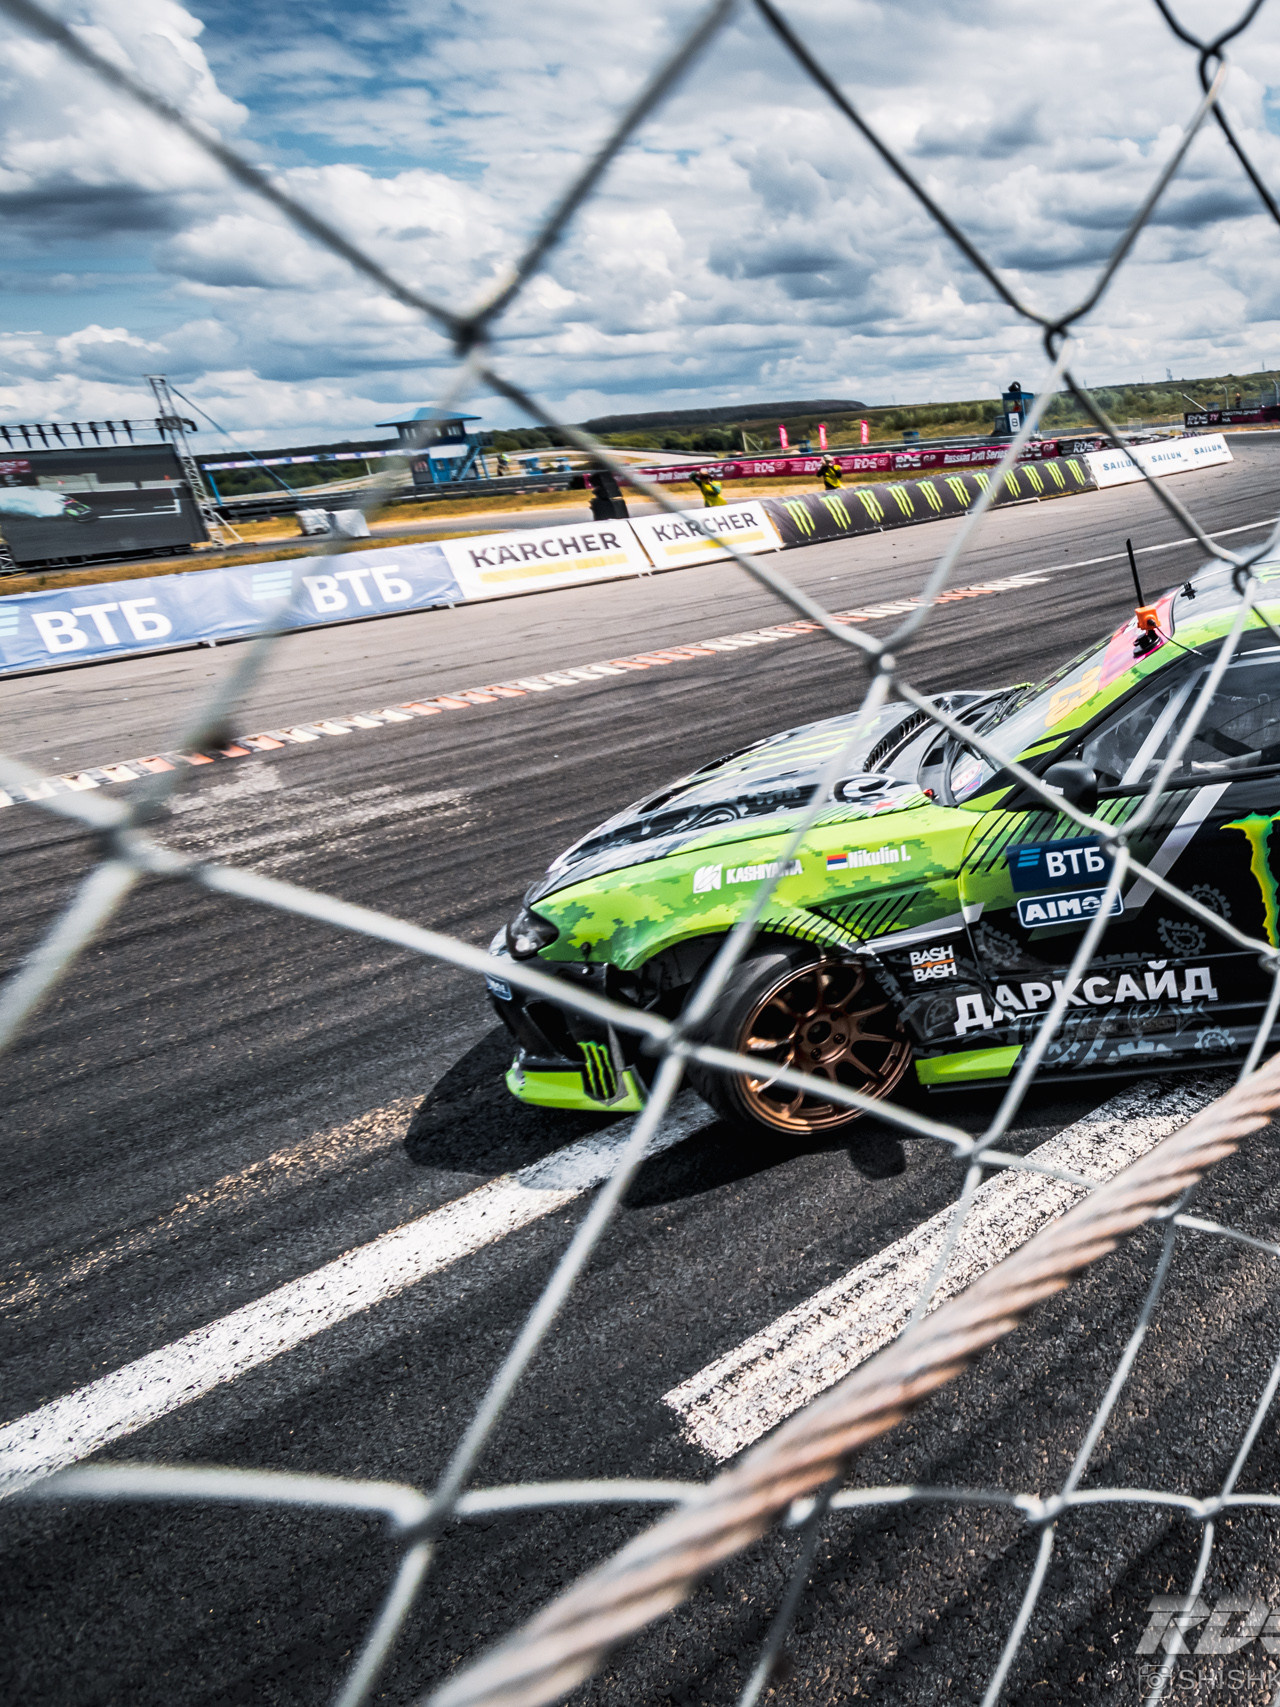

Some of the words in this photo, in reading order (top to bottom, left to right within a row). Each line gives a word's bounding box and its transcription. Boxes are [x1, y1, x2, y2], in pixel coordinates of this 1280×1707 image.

[895, 454, 921, 469] RDS
[1151, 451, 1182, 463] SAILUN
[1193, 444, 1222, 456] SAILUN
[753, 462, 776, 474] RDS
[853, 457, 877, 470] RDS
[652, 512, 759, 542] KÄRCHER
[468, 532, 621, 568] KÄRCHER
[302, 564, 413, 614] ВТБ
[31, 597, 173, 654] ВТБ
[848, 845, 899, 869] Nikulin
[1045, 846, 1105, 878] ВТБ
[909, 944, 954, 966] BASH
[912, 961, 958, 982] BASH
[954, 960, 1218, 1036] ДАРКСАЙД
